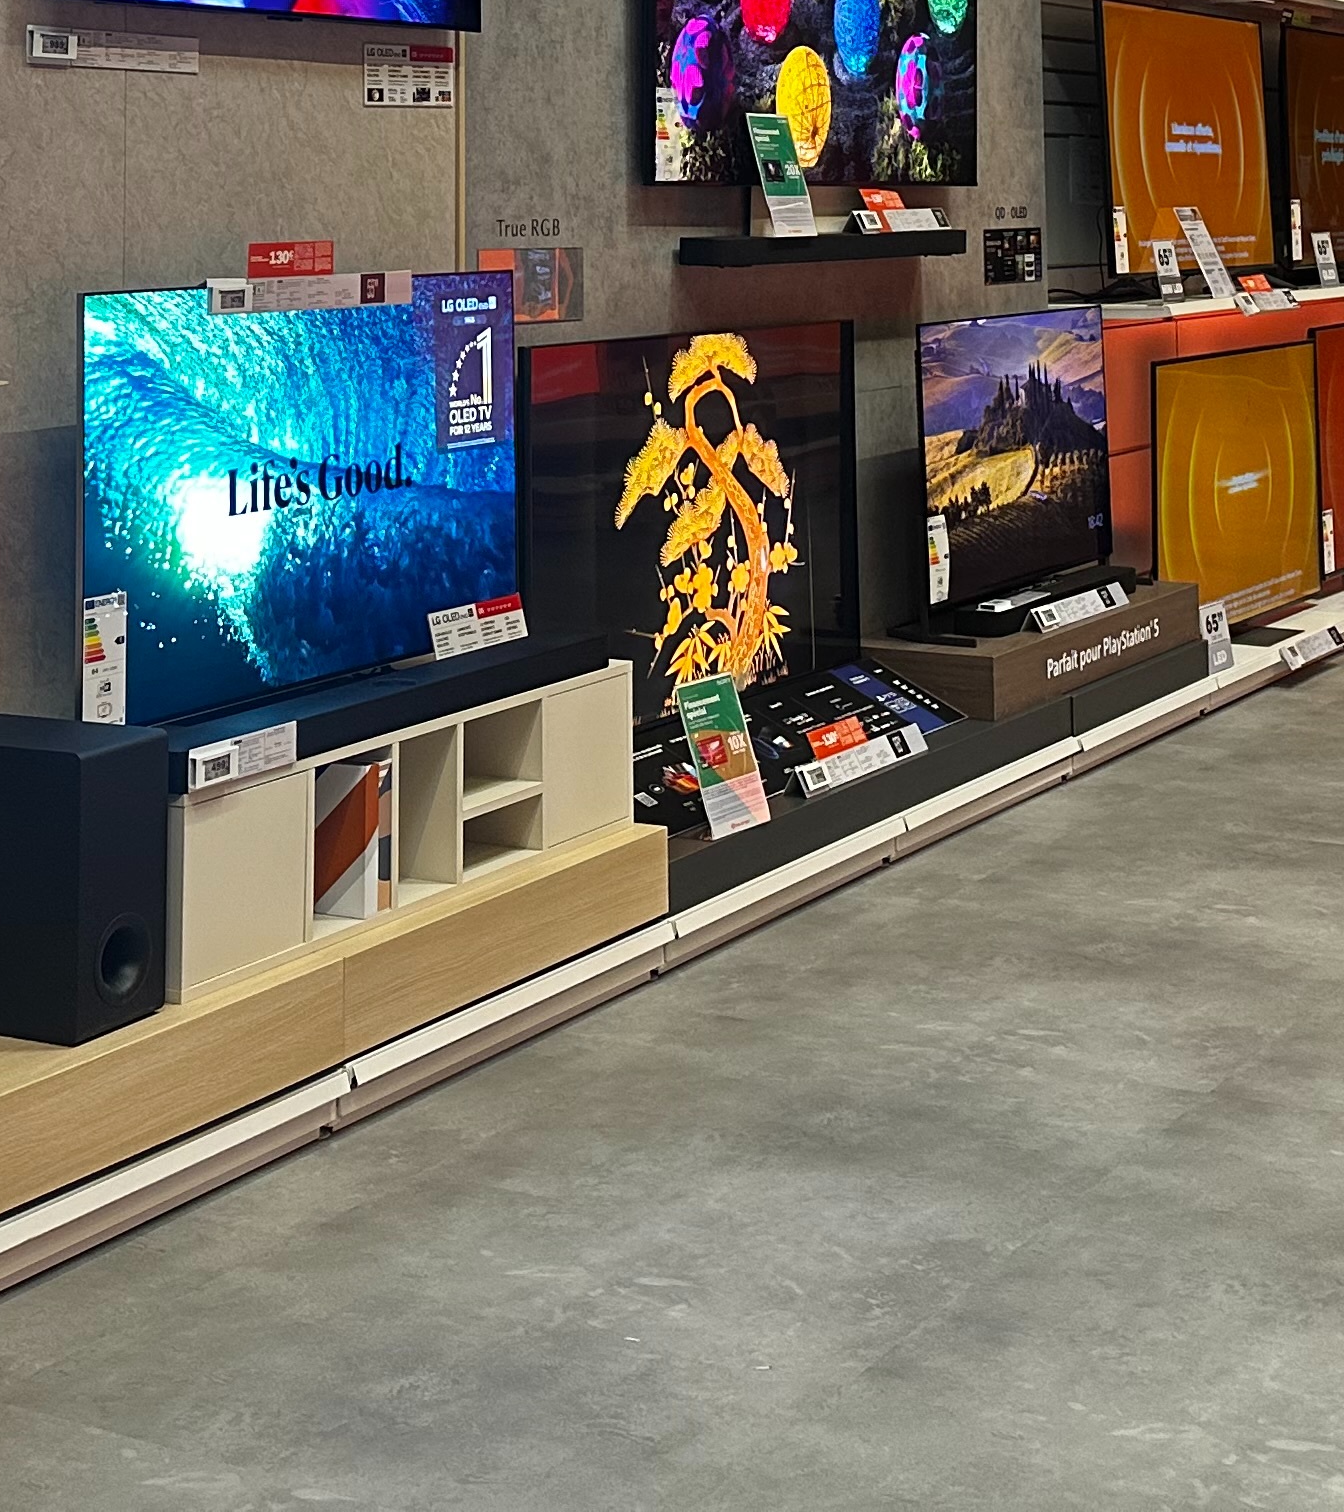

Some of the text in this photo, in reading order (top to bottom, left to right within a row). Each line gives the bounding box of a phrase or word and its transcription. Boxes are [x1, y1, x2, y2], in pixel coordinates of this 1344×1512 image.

[496, 218, 561, 238] True RGB
[441, 299, 454, 313] LG
[455, 297, 479, 312] OLED
[448, 404, 493, 425] OLED TV
[449, 425, 464, 437] FOR
[471, 421, 493, 434] YEARS
[228, 443, 413, 517] Life's Good.
[1046, 649, 1079, 679] Parfait
[1079, 643, 1102, 672] pour
[1212, 649, 1228, 667] LED
